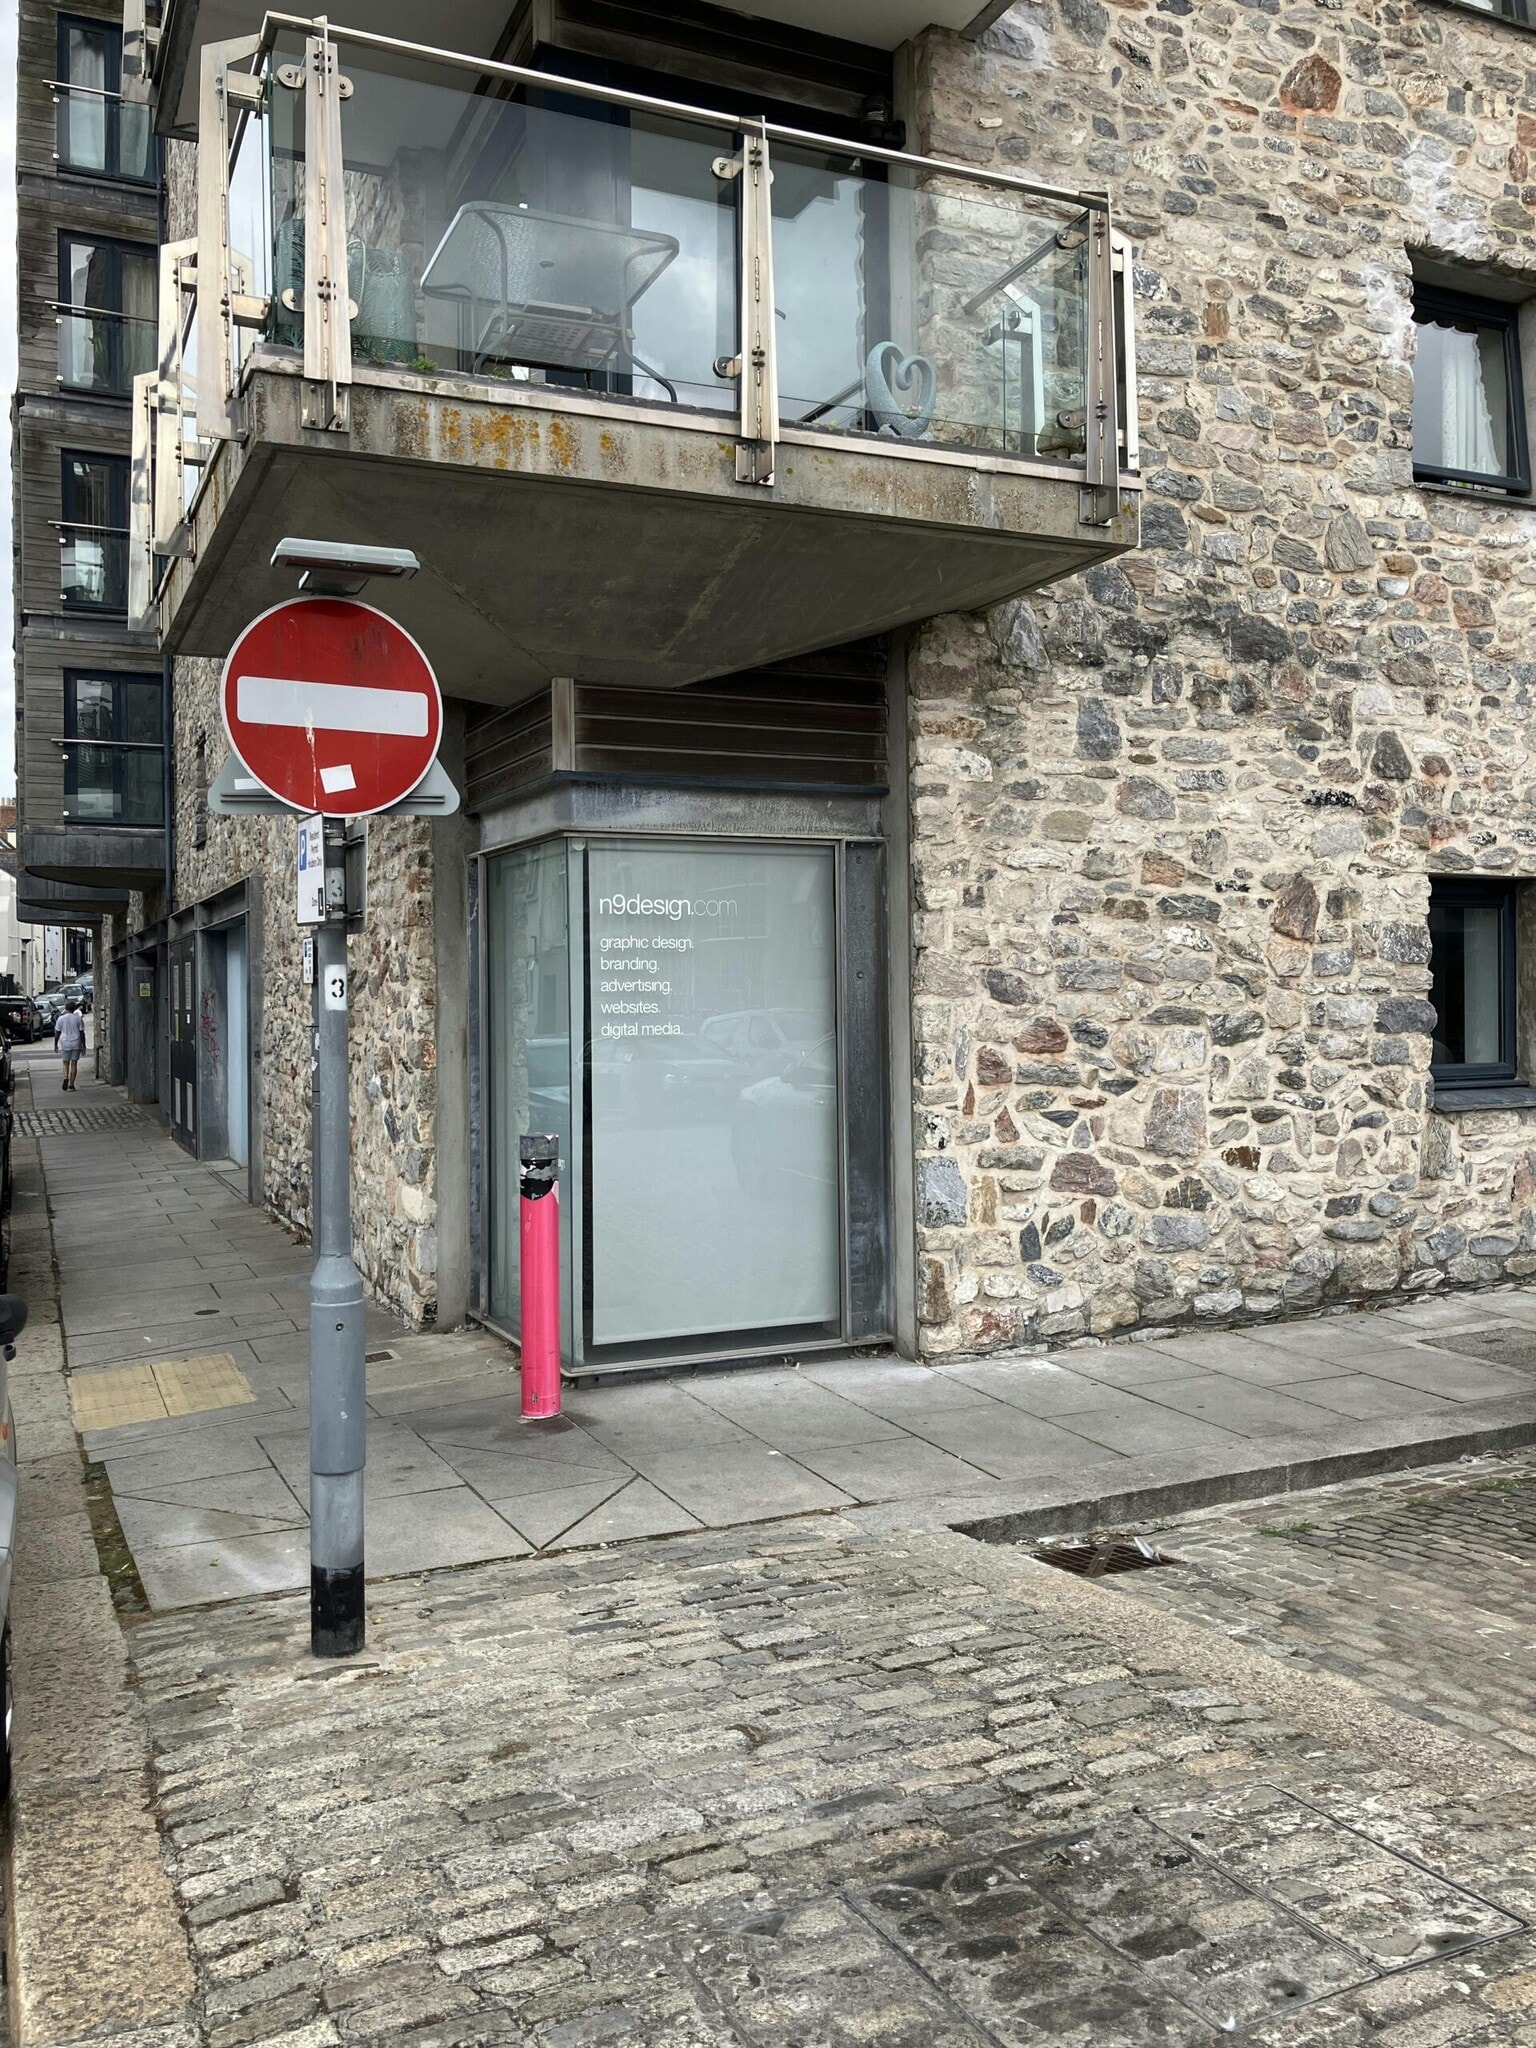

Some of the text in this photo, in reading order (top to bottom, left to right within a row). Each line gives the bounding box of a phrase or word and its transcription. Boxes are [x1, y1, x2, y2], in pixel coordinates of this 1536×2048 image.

[599, 893, 738, 921] n9design.com
[600, 935, 695, 953] graphic design.
[601, 957, 660, 974] branding.
[331, 978, 344, 998] 3
[601, 979, 673, 995] advertising.
[601, 1000, 661, 1014] websites.
[601, 1021, 684, 1040] digital media.
